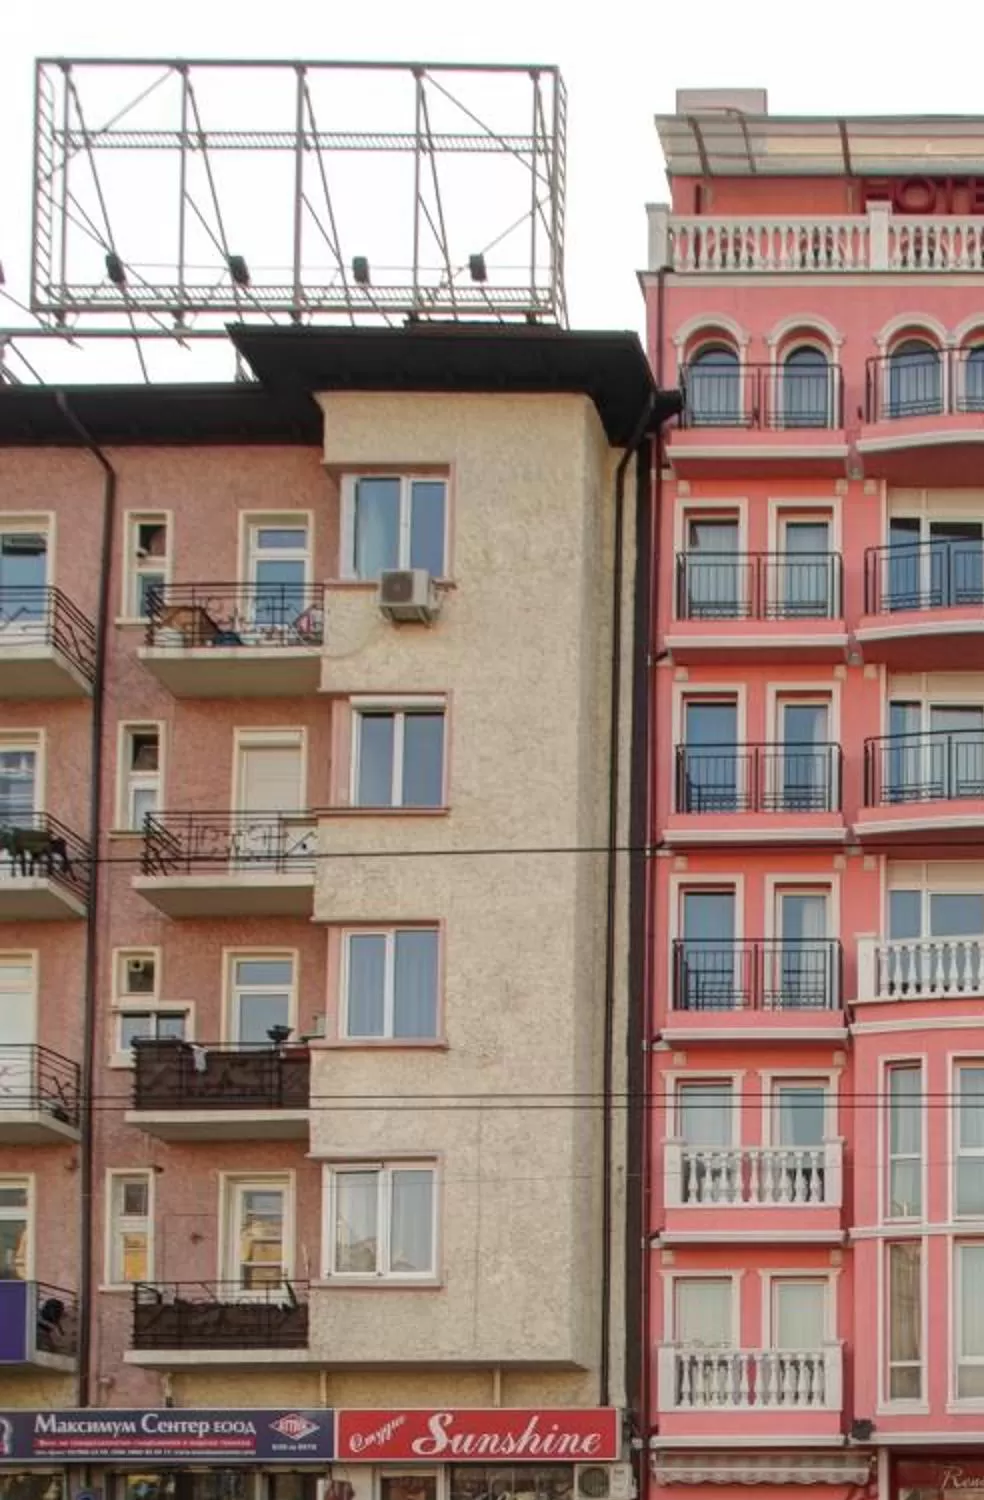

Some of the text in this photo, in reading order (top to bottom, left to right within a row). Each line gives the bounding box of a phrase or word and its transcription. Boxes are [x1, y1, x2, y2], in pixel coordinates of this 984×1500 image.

[34, 1413, 136, 1438] Максимум
[141, 1413, 210, 1438] Сентер
[411, 1412, 601, 1456] Sunshine
